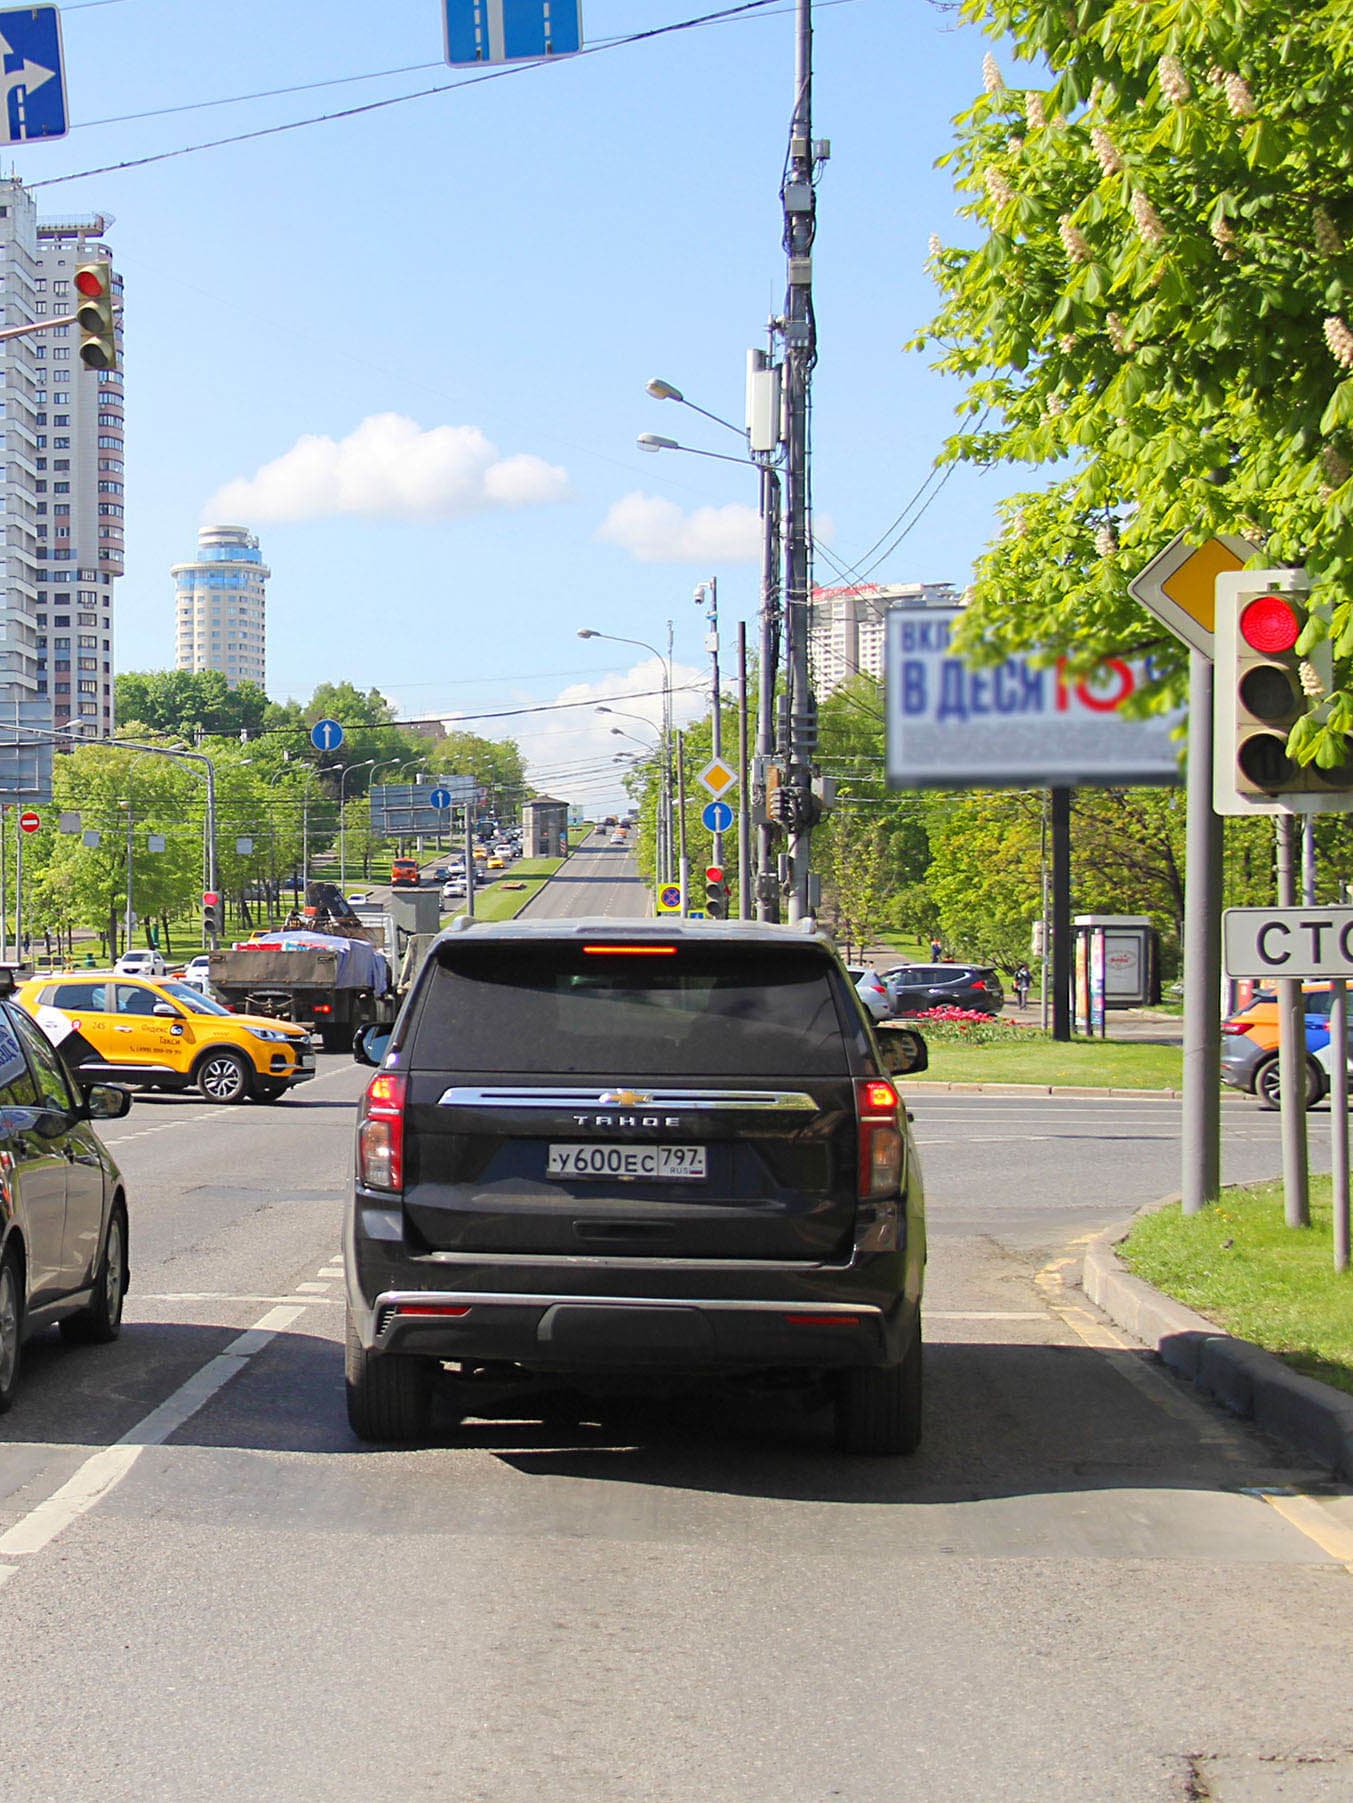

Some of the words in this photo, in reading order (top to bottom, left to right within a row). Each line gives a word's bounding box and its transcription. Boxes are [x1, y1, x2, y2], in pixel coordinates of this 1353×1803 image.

[902, 660, 927, 715] В
[573, 1115, 680, 1127] TAHOE
[661, 1148, 697, 1166] 797
